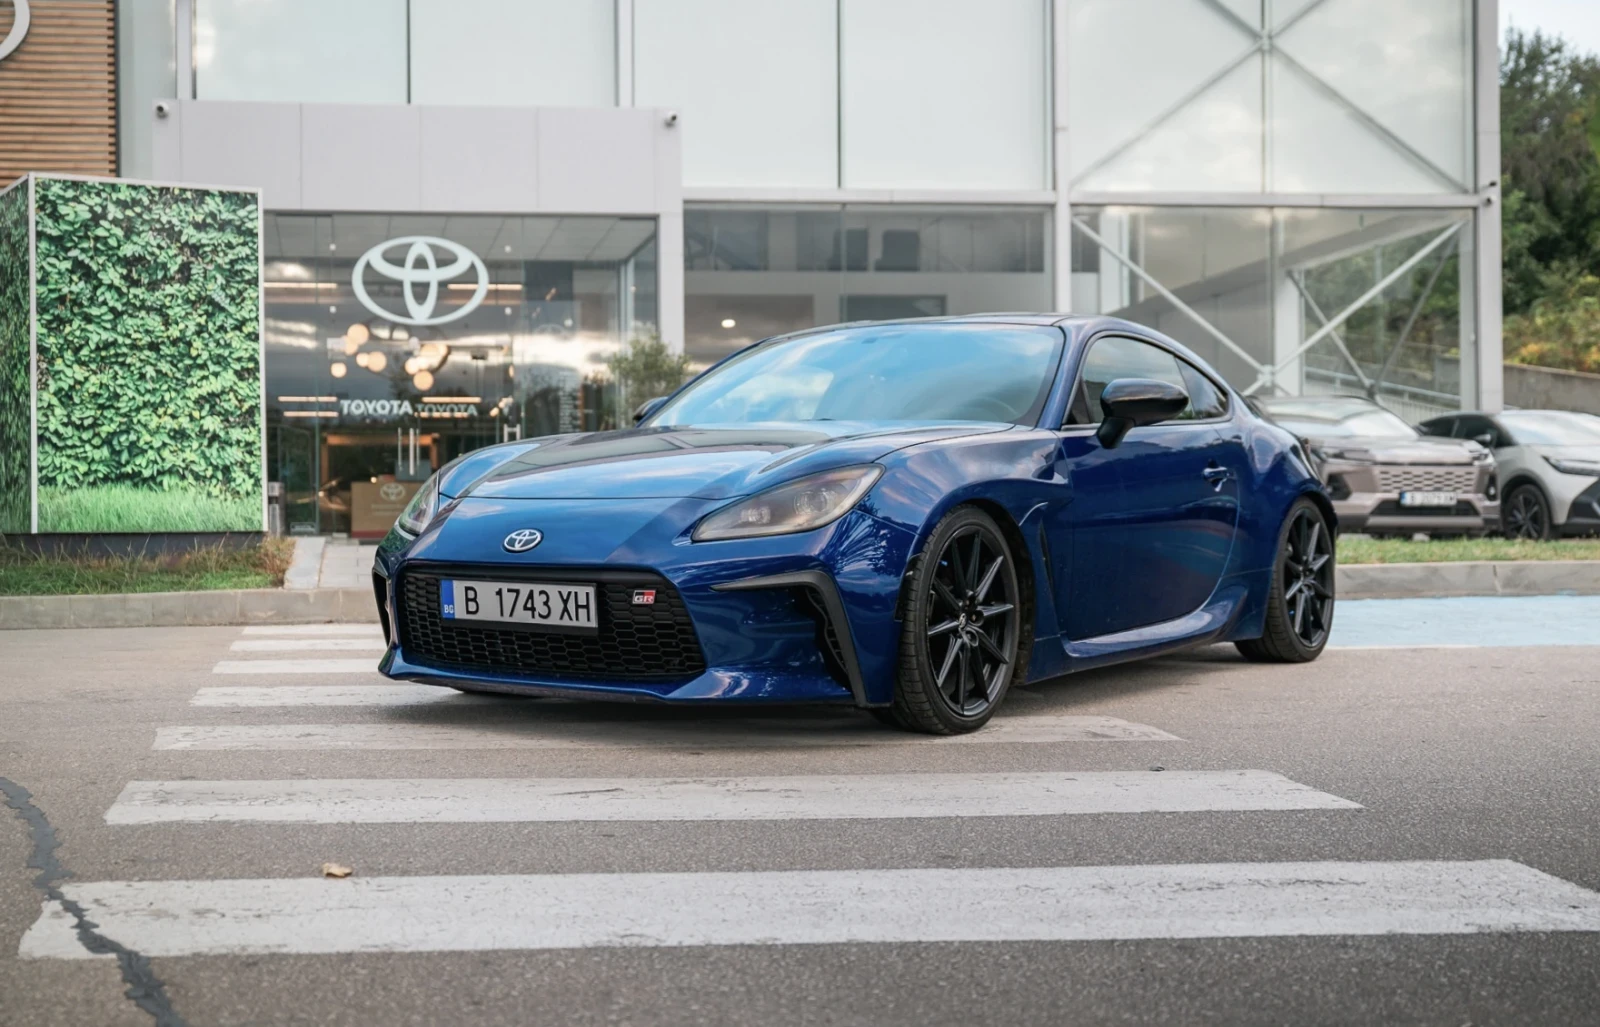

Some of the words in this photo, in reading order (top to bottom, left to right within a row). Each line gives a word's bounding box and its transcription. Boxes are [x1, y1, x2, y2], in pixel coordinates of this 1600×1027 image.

[340, 400, 413, 416] TOYOTA
[415, 403, 478, 417] TOYOTA
[444, 604, 454, 613] BG
[465, 586, 480, 615] B
[495, 588, 551, 619] 1743
[558, 590, 591, 622] XH
